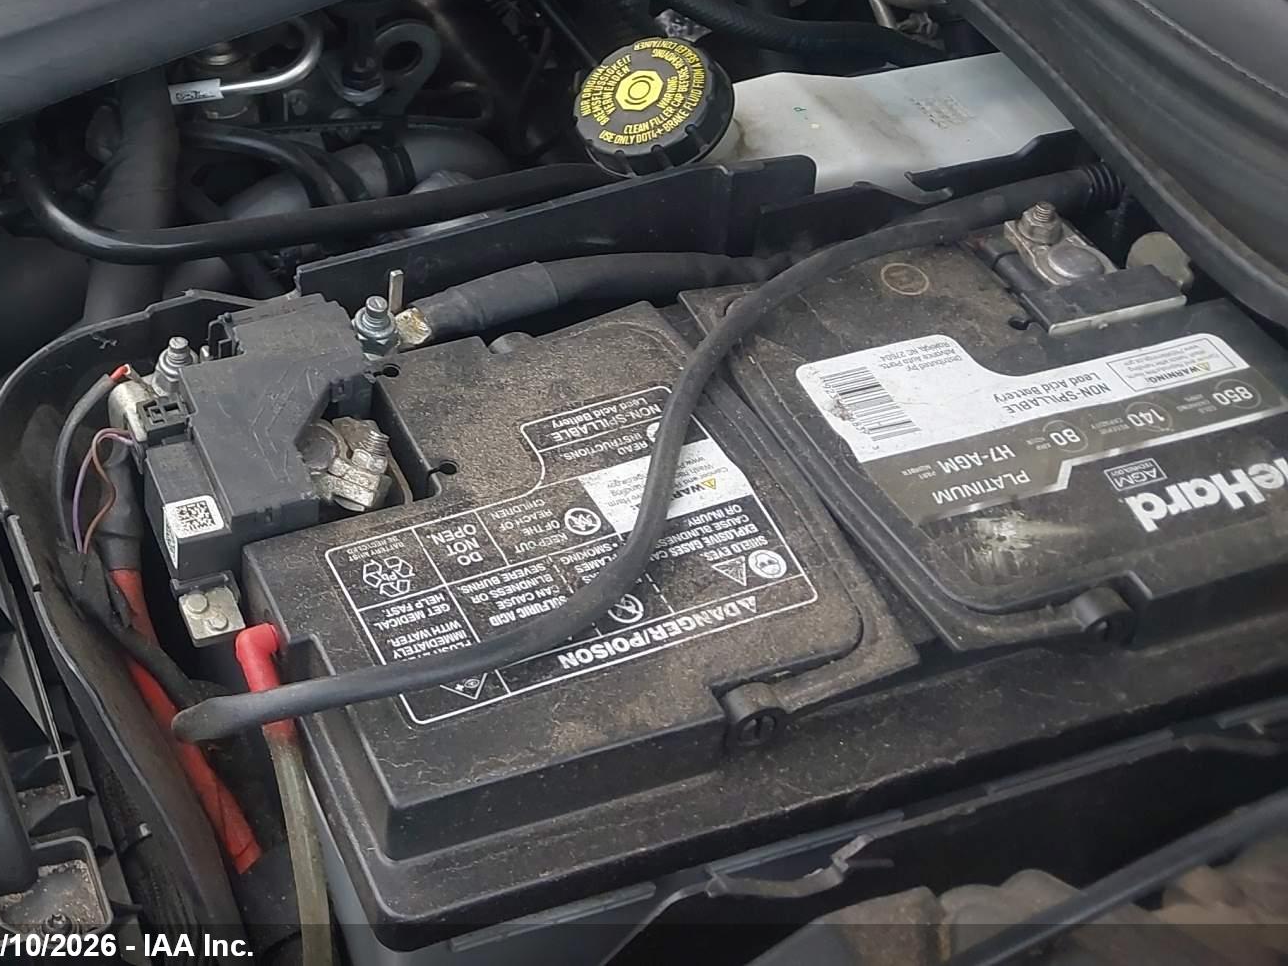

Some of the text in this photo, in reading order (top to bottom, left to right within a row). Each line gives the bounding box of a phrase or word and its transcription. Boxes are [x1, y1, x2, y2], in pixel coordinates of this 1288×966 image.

[677, 66, 690, 92] BEFORE
[693, 69, 704, 88] FROM
[657, 76, 678, 108] WARNING
[672, 93, 685, 107] CAP
[685, 89, 703, 111] FLUID
[624, 121, 649, 135] CLEAN
[650, 106, 676, 128] FILLER
[664, 109, 690, 132] BRAKE
[599, 130, 614, 143] USE
[614, 136, 633, 145] ONLY
[991, 371, 1101, 404] Lead Acid Battery
[1001, 380, 1110, 416] NON-SPILLABLE
[1210, 383, 1254, 406] 850
[549, 395, 647, 430] Lead Acid Battery
[549, 401, 662, 443] NON-SPILLABLE
[1125, 406, 1165, 428] 140
[616, 439, 648, 455] READ
[1047, 426, 1081, 447] 80
[935, 443, 1016, 474] H7-AGM
[929, 469, 1031, 504] PLATINUM
[1114, 468, 1159, 488] AGM
[496, 507, 554, 531] REACH OF
[722, 503, 742, 515] OR
[520, 518, 561, 537] OF THE
[711, 512, 750, 530] CAUSE
[425, 521, 478, 546] OPEN.
[511, 531, 568, 553] KEEP OUT
[700, 521, 758, 546] EXPLOSIVE
[728, 534, 768, 553] SHIELD
[369, 540, 404, 556] BATTERY
[442, 536, 480, 556] NOT
[667, 538, 704, 556] GASES
[455, 550, 483, 566] DO
[380, 570, 397, 581] Pb
[455, 561, 546, 595] SEVERE BURNS.
[469, 572, 553, 604] BLINDNESS OR
[494, 583, 560, 610] CAN CAUSE
[380, 591, 445, 618] HELP FAST.
[487, 593, 569, 627] SULFURIC ACID
[373, 601, 451, 632] GET MEDICAL
[385, 618, 460, 648] WITH WATER.
[390, 628, 467, 659] IMMEDIATELY
[556, 599, 743, 671] DANGER/POISON
